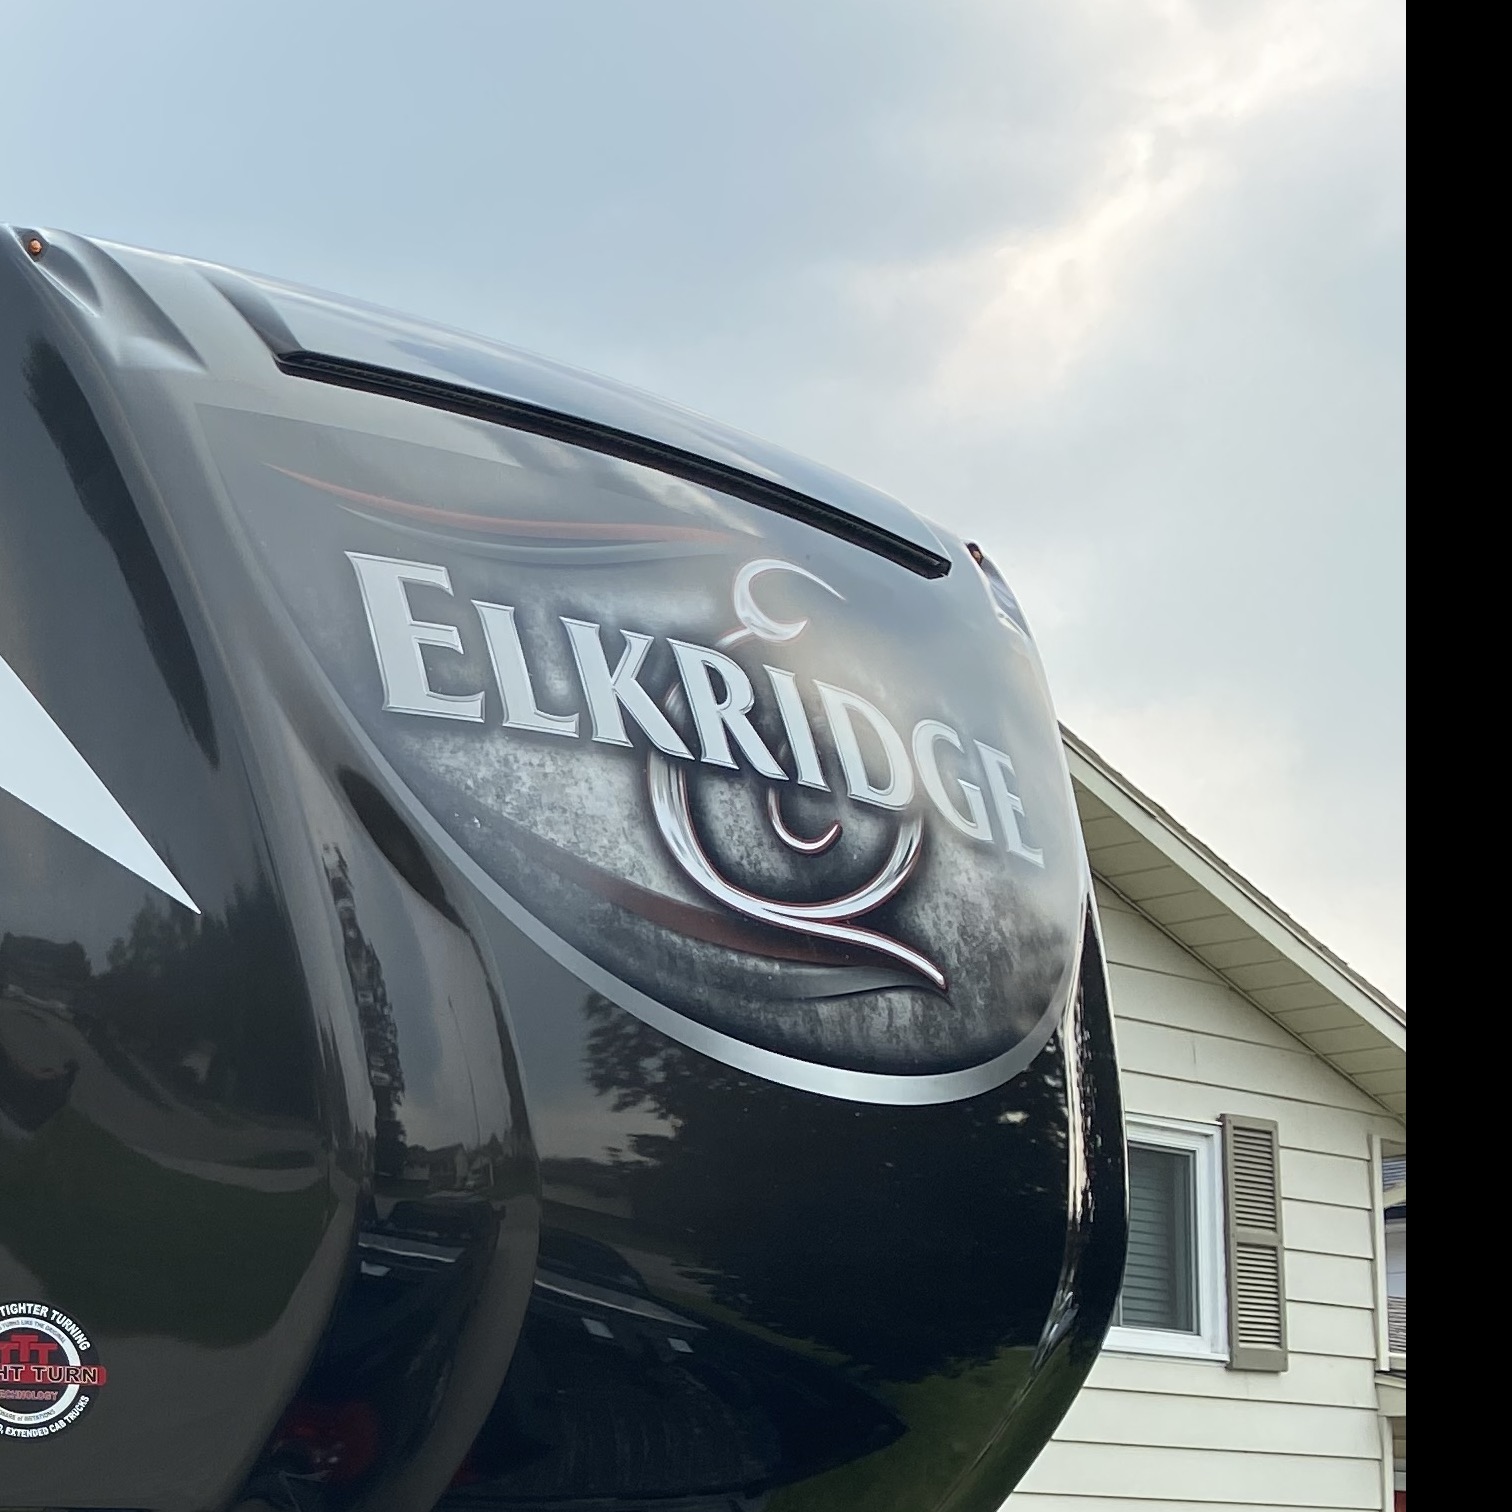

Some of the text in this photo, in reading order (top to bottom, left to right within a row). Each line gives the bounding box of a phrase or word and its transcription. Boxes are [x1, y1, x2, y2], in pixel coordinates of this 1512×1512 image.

[343, 550, 1046, 869] ELKRIDGE
[50, 1309, 91, 1351] TURNING
[30, 1365, 98, 1384] TURN
[4, 1426, 50, 1438] EXTENDED
[48, 1419, 67, 1433] CAB
[63, 1395, 90, 1424] TRUCKS
